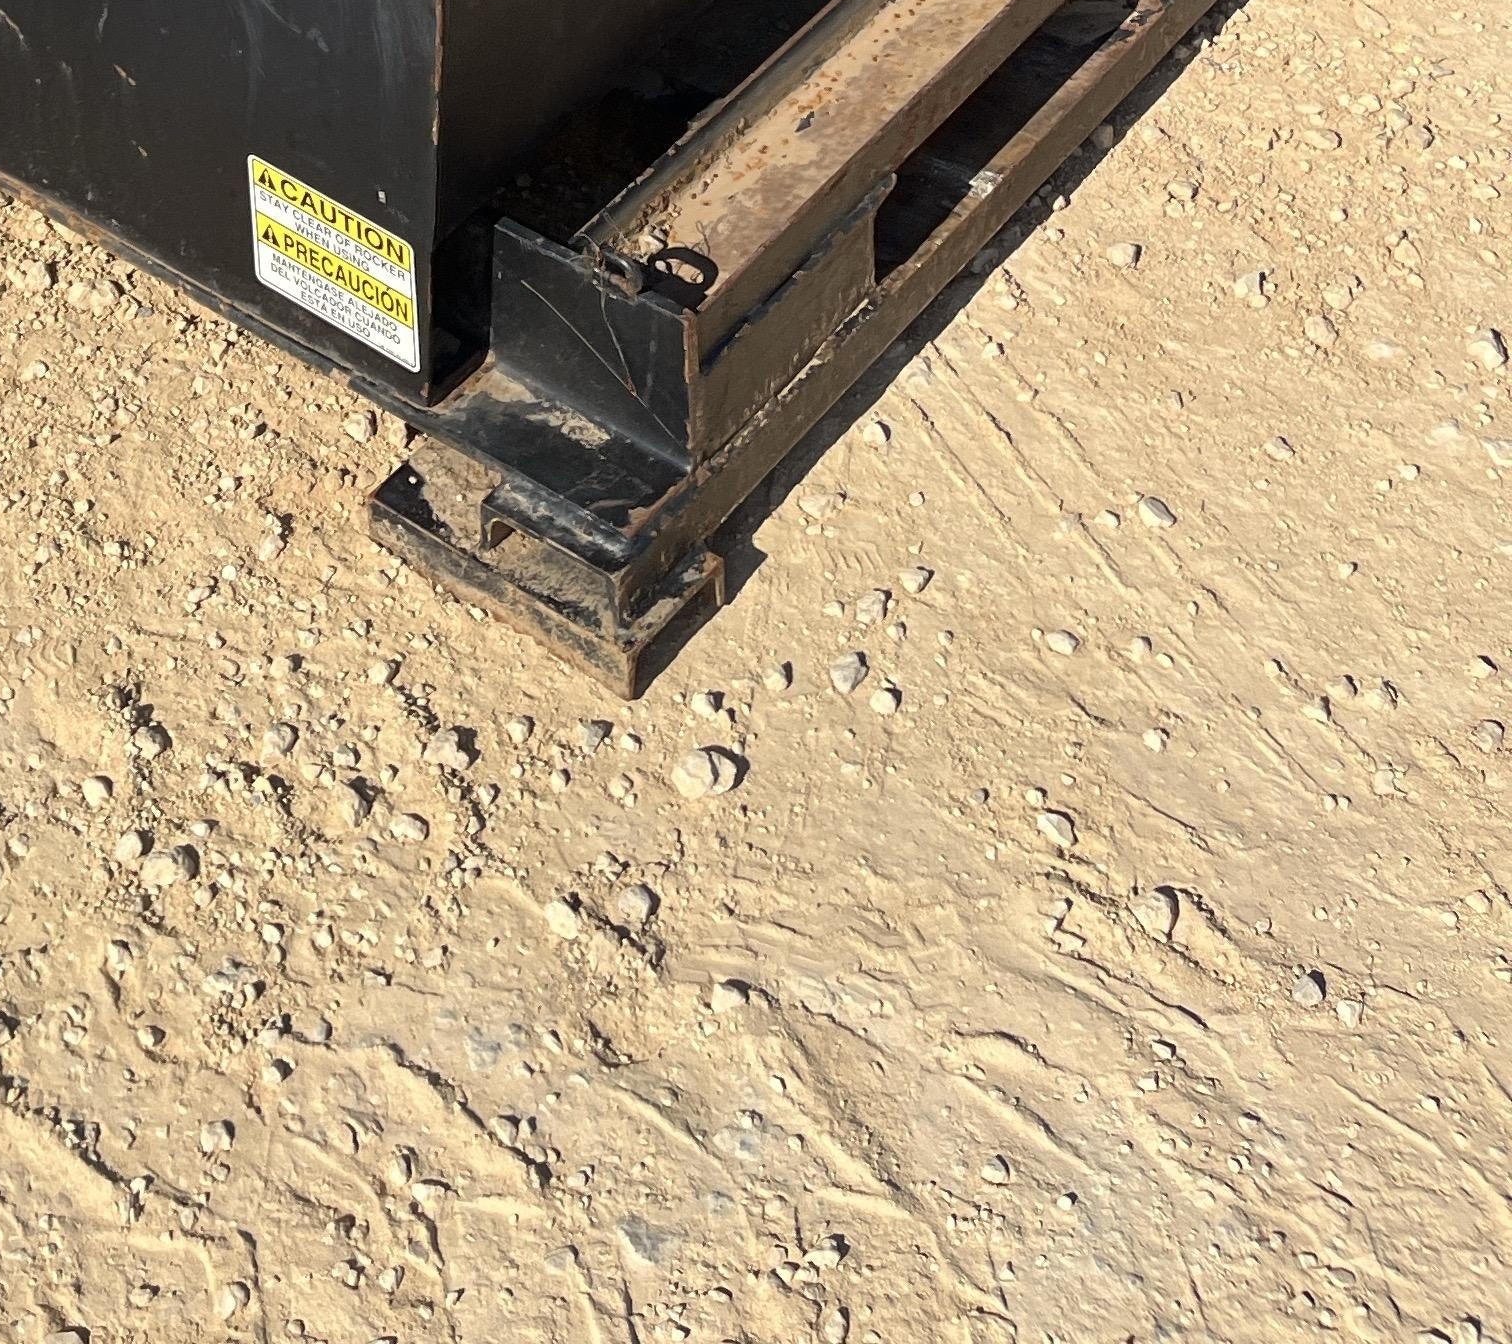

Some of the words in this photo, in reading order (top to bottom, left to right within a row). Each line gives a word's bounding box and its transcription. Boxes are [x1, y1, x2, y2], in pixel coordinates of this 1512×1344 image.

[259, 190, 290, 213] STAY
[292, 209, 333, 238] CLEAR
[335, 233, 351, 248] OF
[354, 244, 406, 281] ROCKER
[280, 178, 404, 265] CAUTION
[294, 222, 330, 250] WHEN
[333, 245, 370, 273] USING
[270, 262, 290, 280] DEL
[293, 274, 352, 316] VOLCADOR
[354, 308, 401, 345] CUANDO
[283, 232, 409, 322] PRECAUCIÓN
[348, 295, 398, 332] ALEJADO
[331, 307, 347, 326] EN
[349, 317, 371, 339] USO
